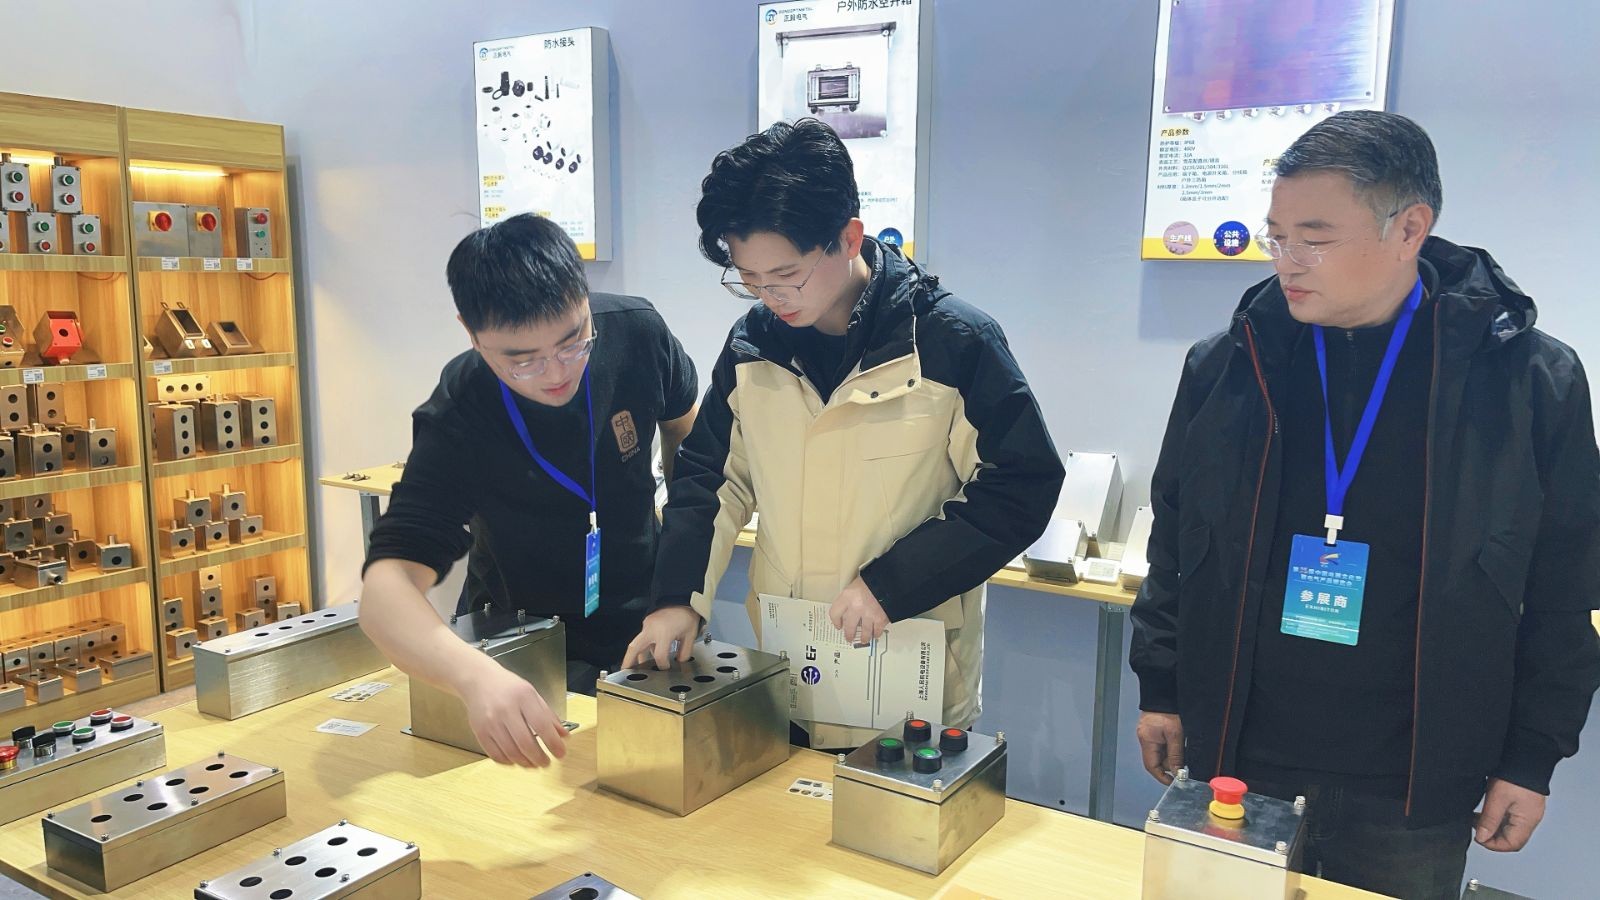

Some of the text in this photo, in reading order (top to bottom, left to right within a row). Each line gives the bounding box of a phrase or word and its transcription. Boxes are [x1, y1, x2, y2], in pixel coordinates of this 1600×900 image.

[544, 37, 575, 50] 防水接头
[1160, 128, 1189, 137] 产品参数
[1169, 234, 1193, 243] 生产线
[1223, 230, 1240, 239] 公共
[621, 446, 641, 463] CHINA
[1300, 589, 1348, 609] 参展商
